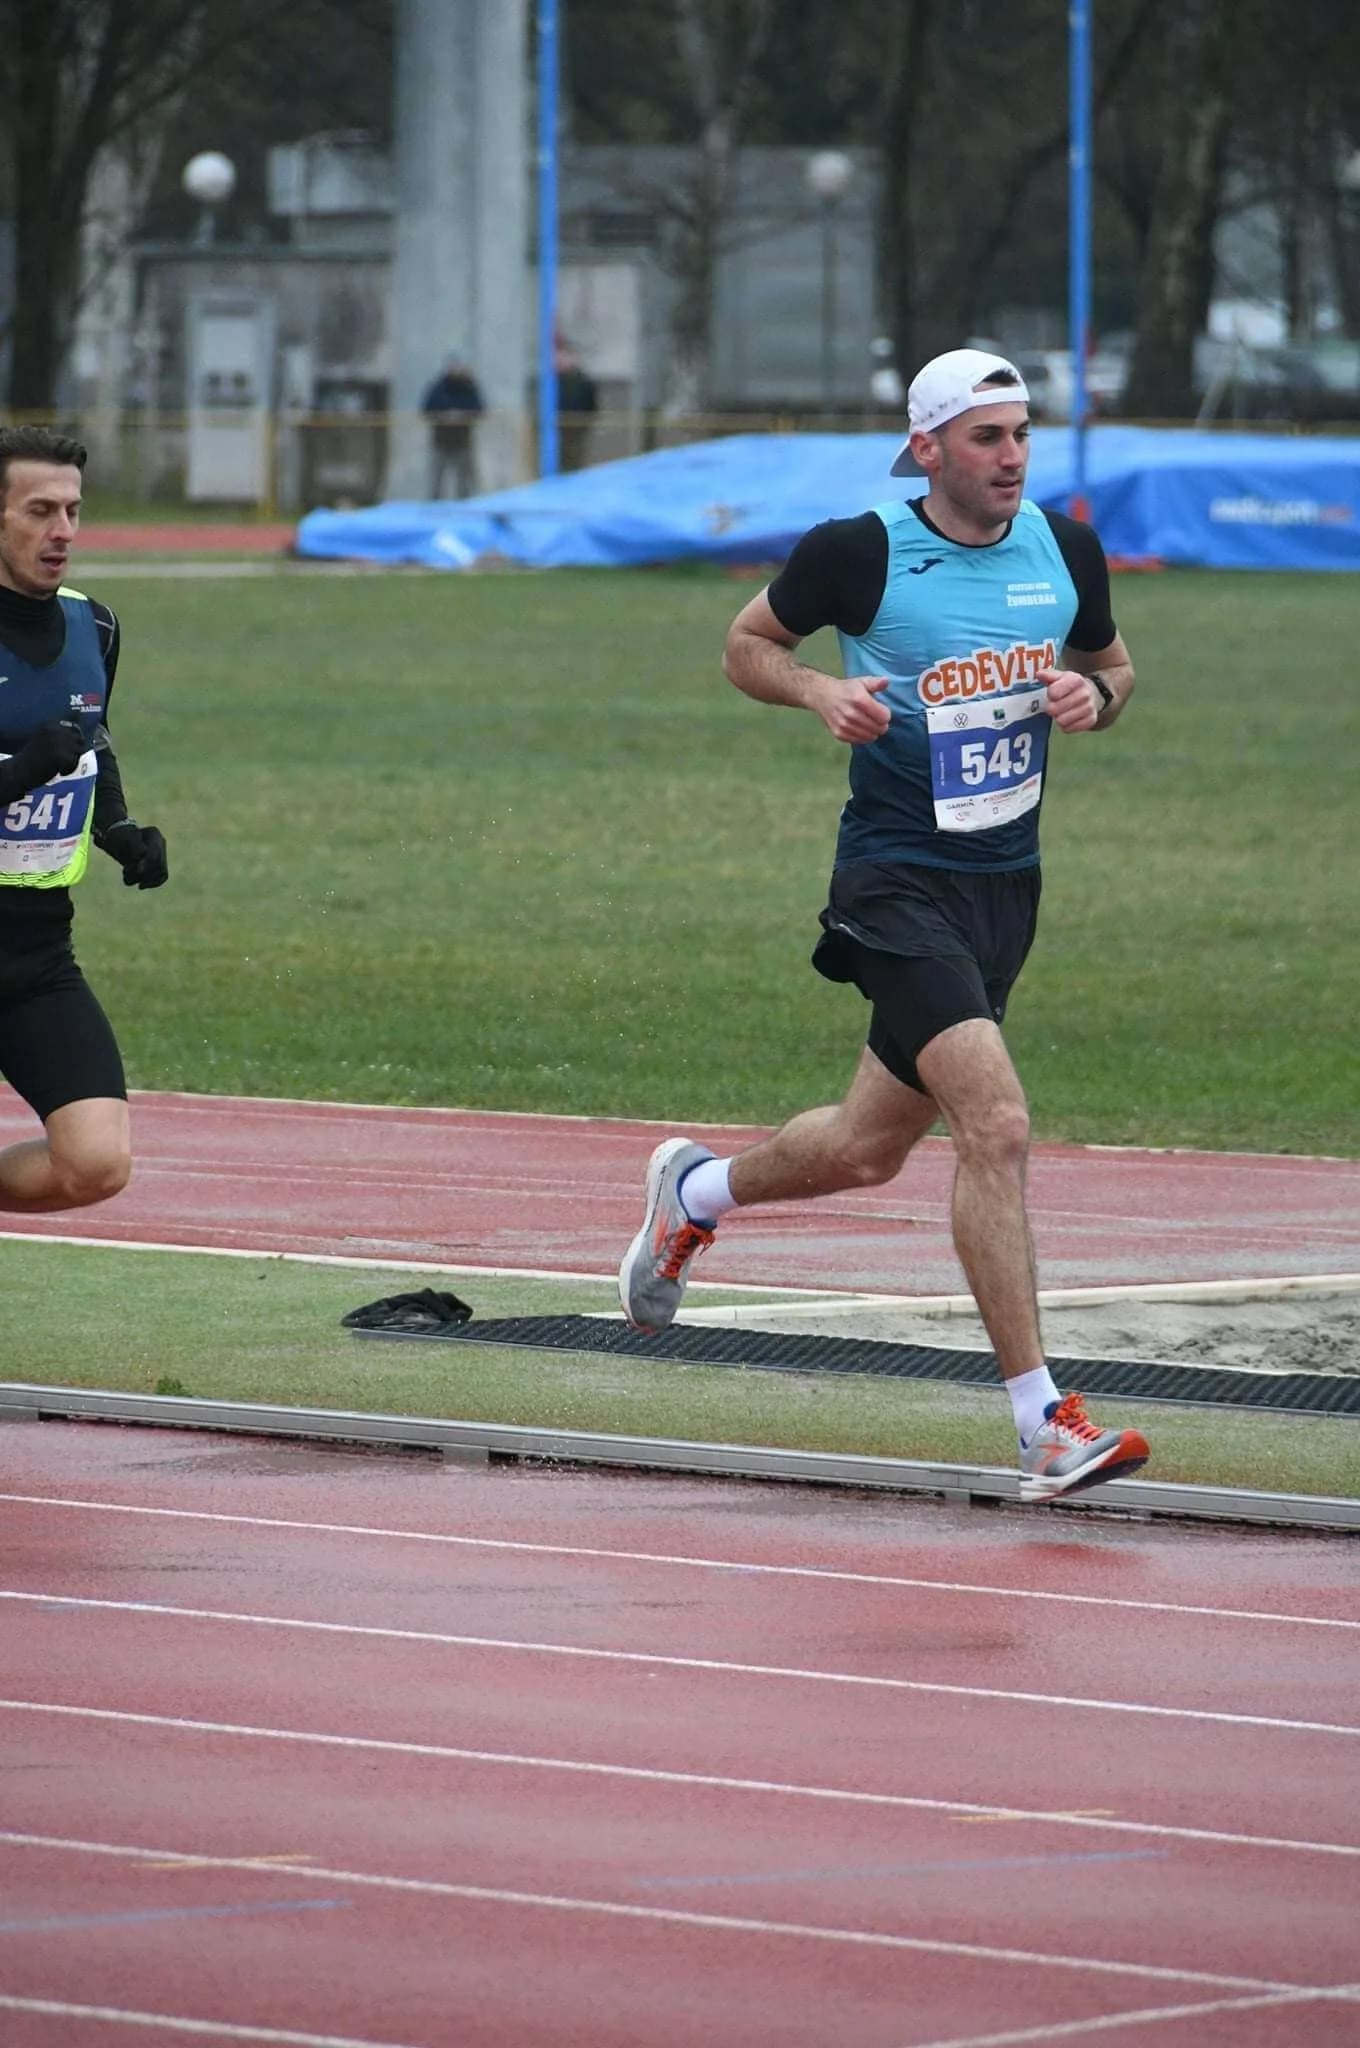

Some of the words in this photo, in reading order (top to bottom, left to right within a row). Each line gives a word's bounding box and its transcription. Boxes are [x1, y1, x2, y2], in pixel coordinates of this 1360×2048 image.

[920, 640, 1056, 704] CEDEVITA
[961, 732, 1032, 785] 543
[4, 791, 75, 832] 541
